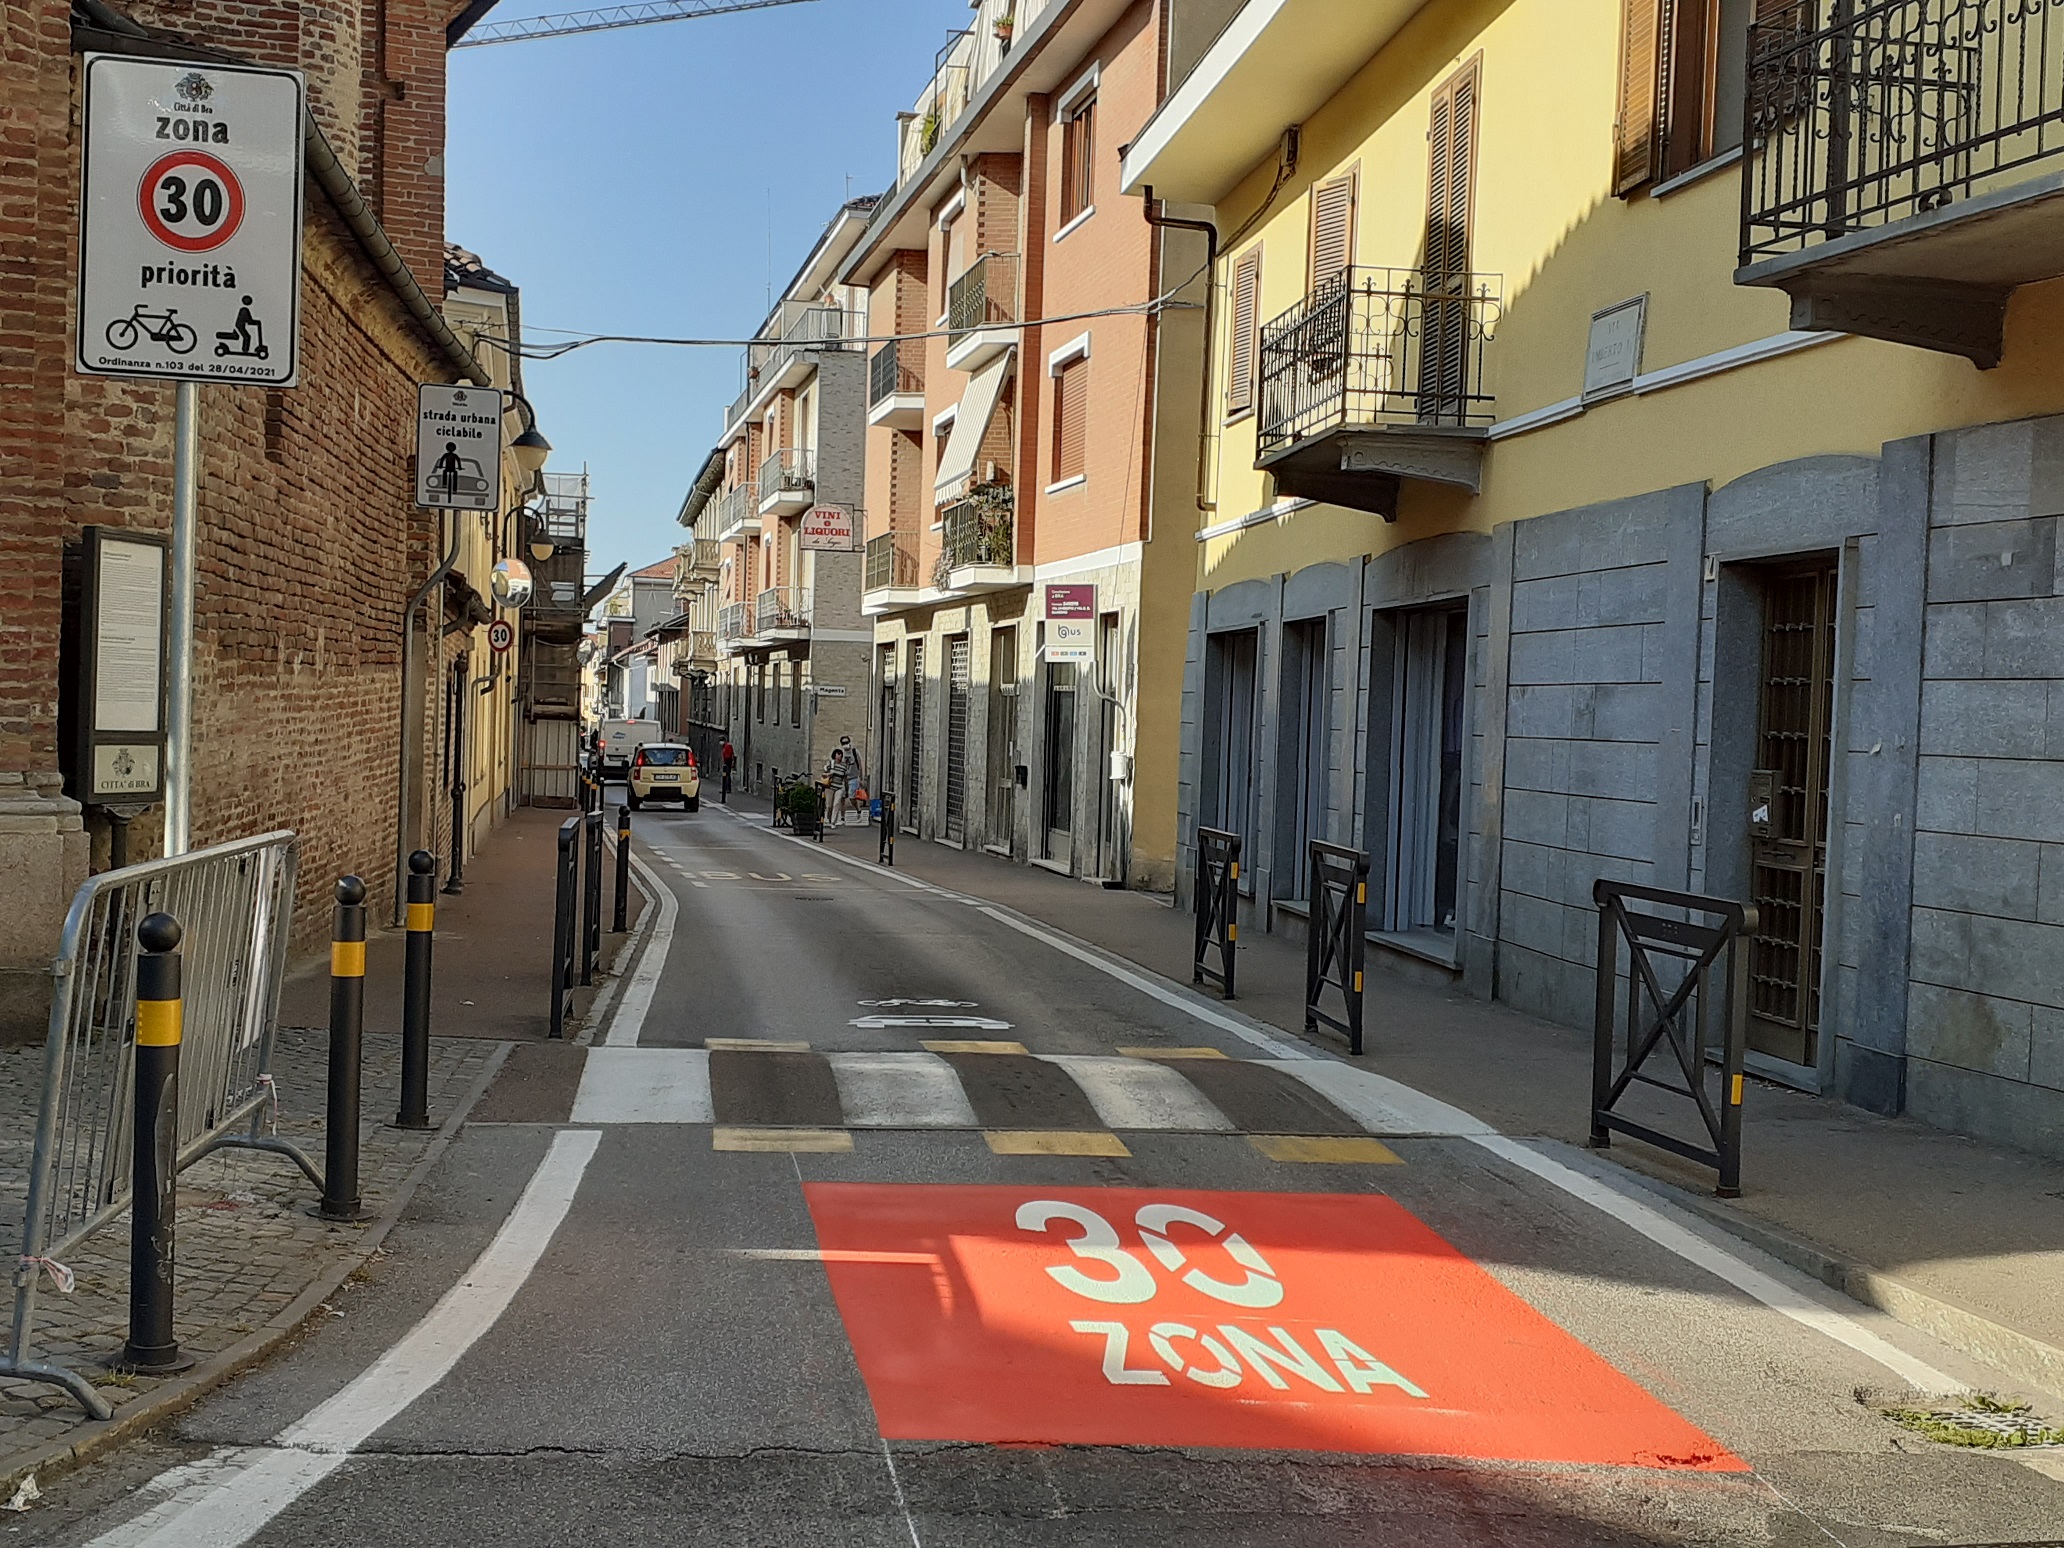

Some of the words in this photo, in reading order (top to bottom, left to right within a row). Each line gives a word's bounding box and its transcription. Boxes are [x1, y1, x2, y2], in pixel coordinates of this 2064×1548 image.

[192, 104, 199, 113] di
[155, 116, 229, 144] zona
[160, 176, 222, 226] 30
[141, 261, 236, 289] priorità
[99, 356, 151, 369] Ordinanza
[155, 360, 184, 371] n.103
[188, 363, 204, 372] del
[208, 364, 276, 377] 28/04/2021
[423, 409, 457, 422] strada
[460, 412, 496, 425] urbana
[436, 425, 483, 439] ciclabile
[814, 511, 841, 520] VINI
[803, 526, 851, 536] LIQUORI
[493, 628, 508, 642] 30
[135, 780, 151, 788] BRA
[699, 860, 842, 882] BUS
[1014, 1200, 1285, 1308] 30
[1068, 1320, 1431, 1399] ZONA
